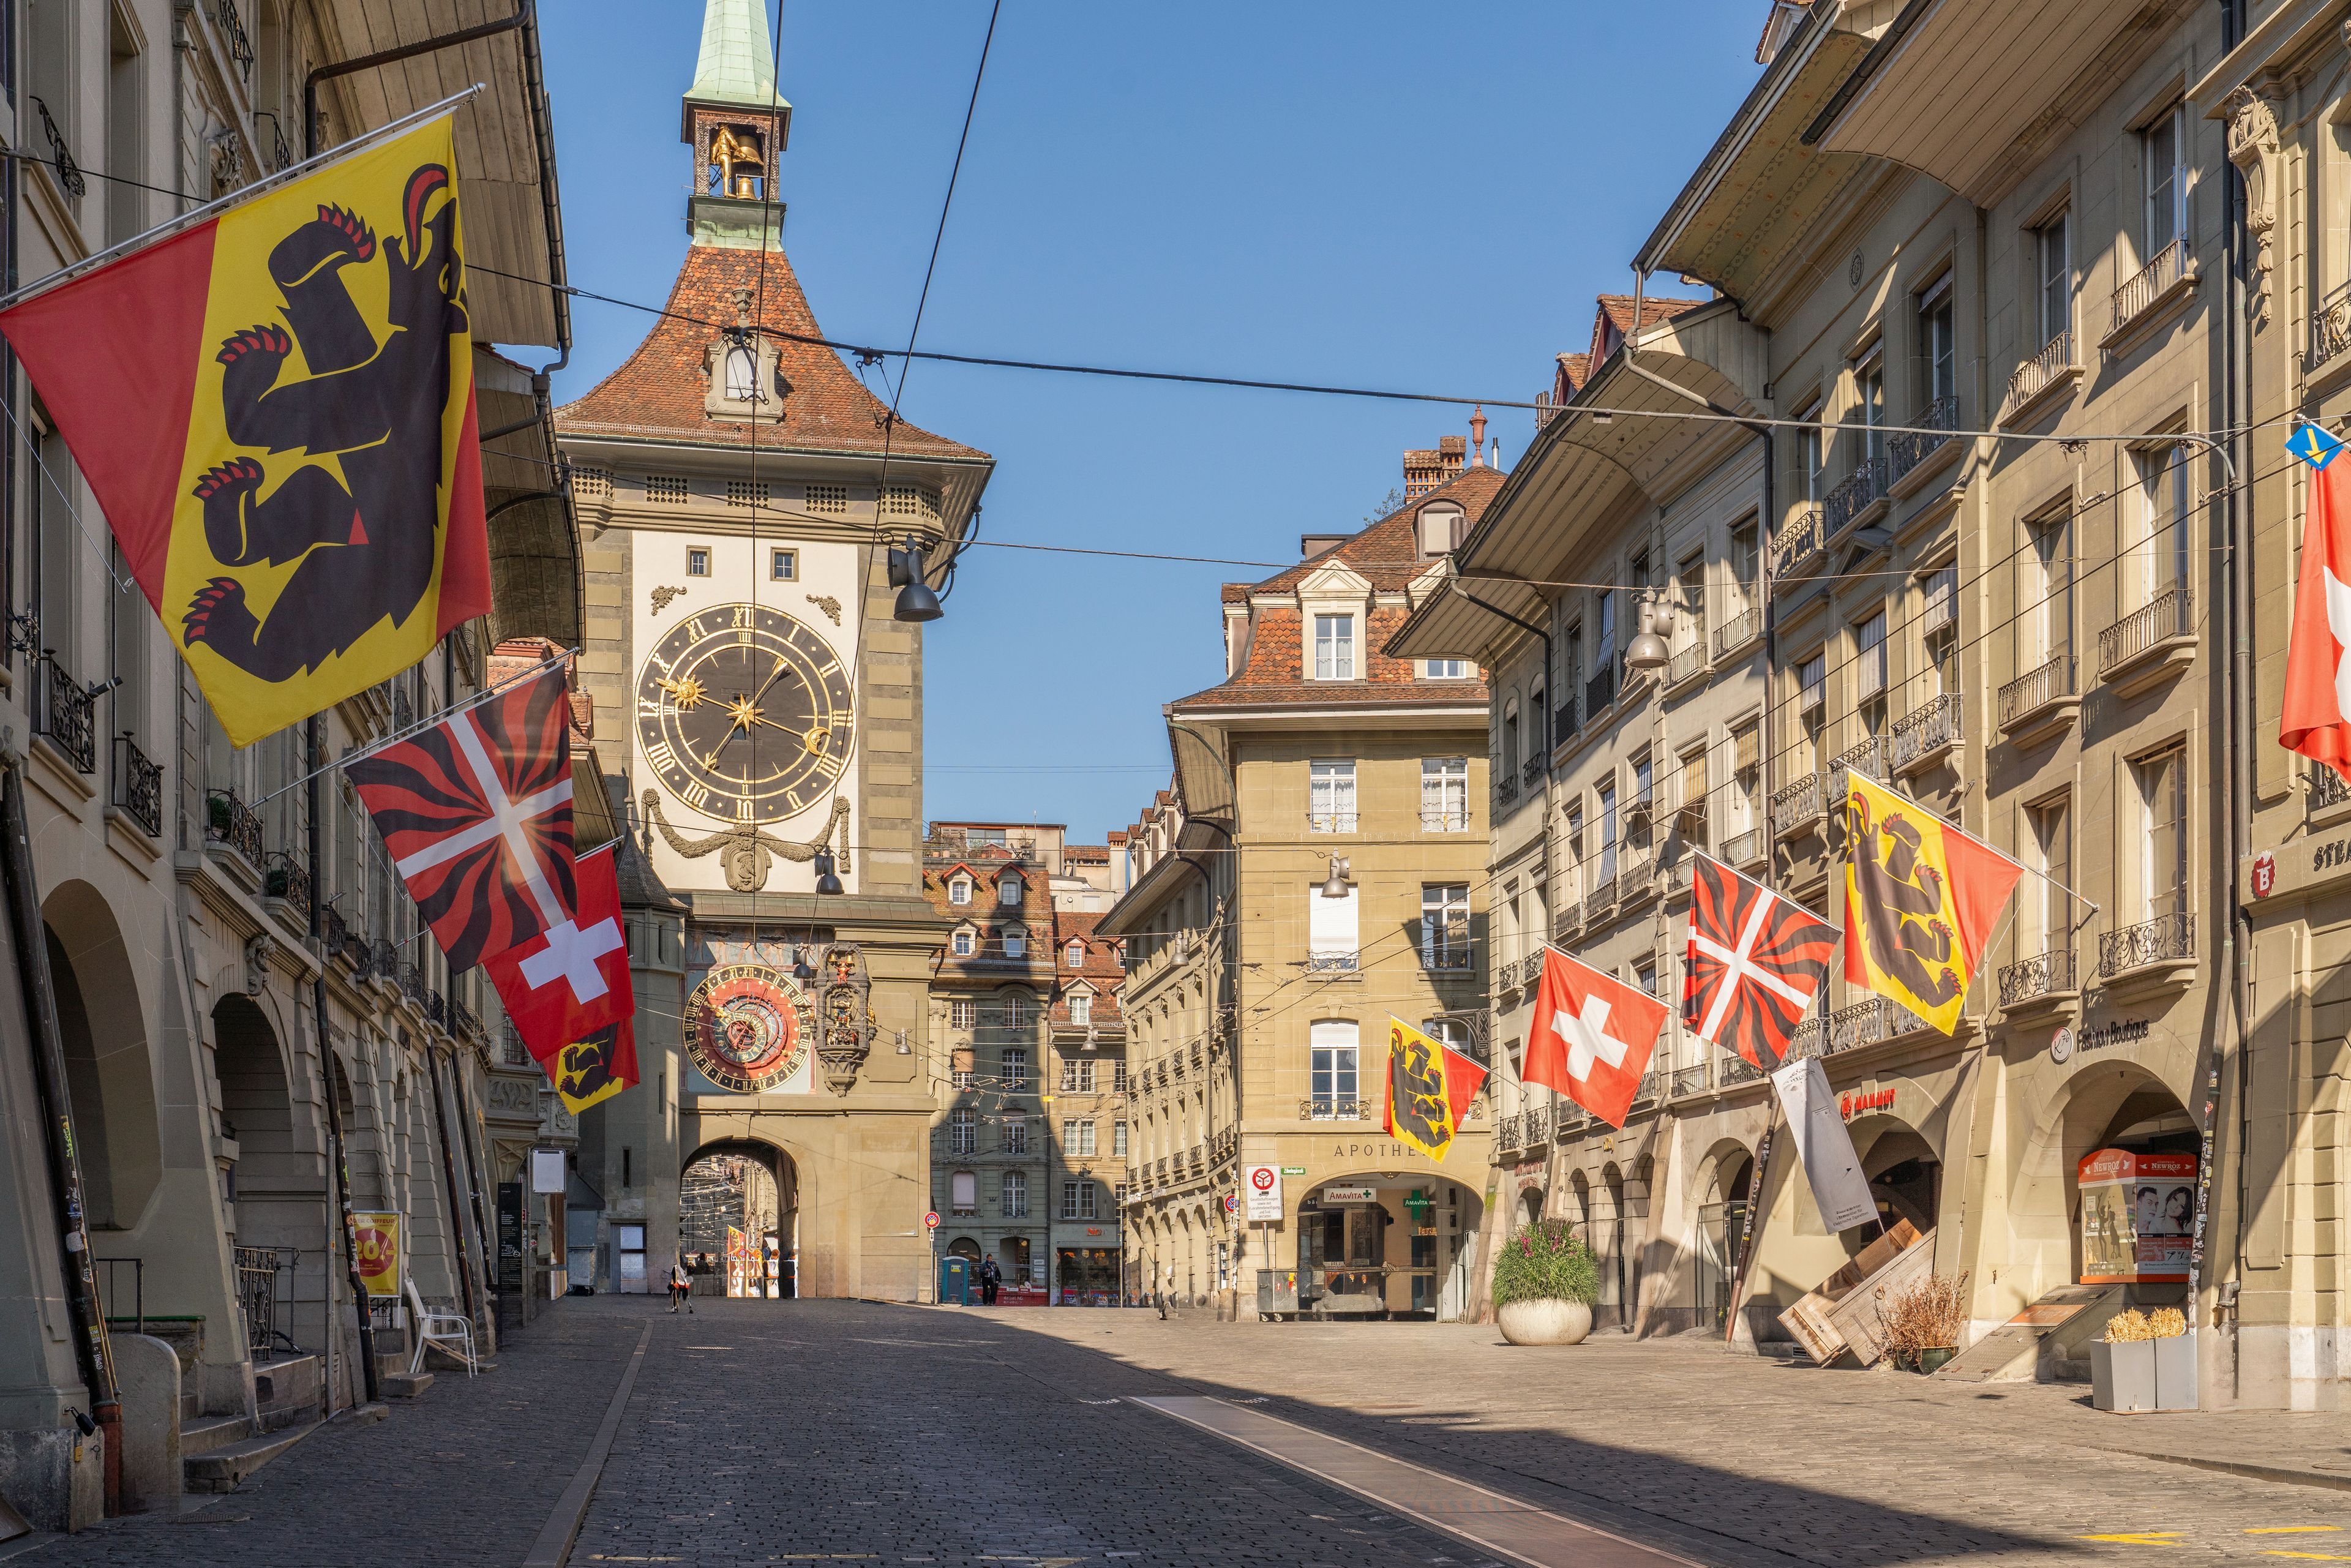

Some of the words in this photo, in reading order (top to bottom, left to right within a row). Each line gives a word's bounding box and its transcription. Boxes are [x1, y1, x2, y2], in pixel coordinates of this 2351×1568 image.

[2077, 1026, 2109, 1053] Fashion
[2110, 1018, 2150, 1045] Boutique
[1855, 1088, 1895, 1110] MAMMUT
[1334, 1144, 1427, 1157] APOTHE
[2094, 1161, 2120, 1172] NEWROZ
[1329, 1191, 1362, 1200] AMAVITA
